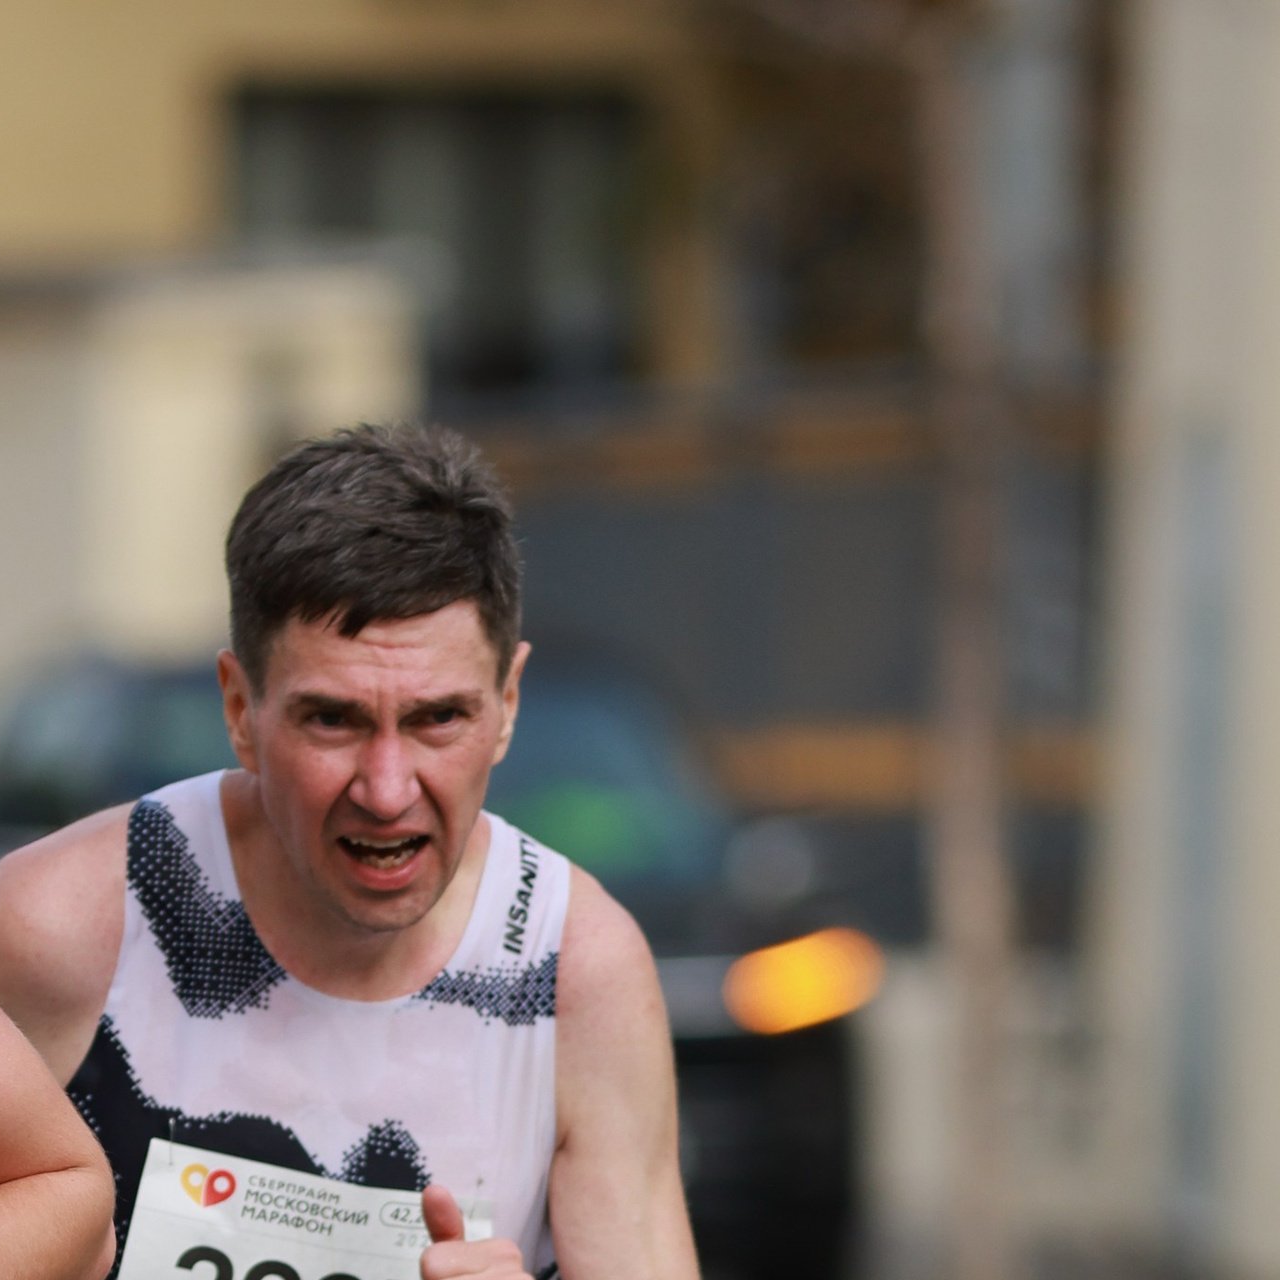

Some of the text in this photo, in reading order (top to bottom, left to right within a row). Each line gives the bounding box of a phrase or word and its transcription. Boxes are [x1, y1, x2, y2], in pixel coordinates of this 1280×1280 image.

[248, 1175, 340, 1204] СБЕРПРАЙМ
[241, 1205, 333, 1236] МАРАФОН
[244, 1189, 369, 1226] МОСКОВСКИЙ
